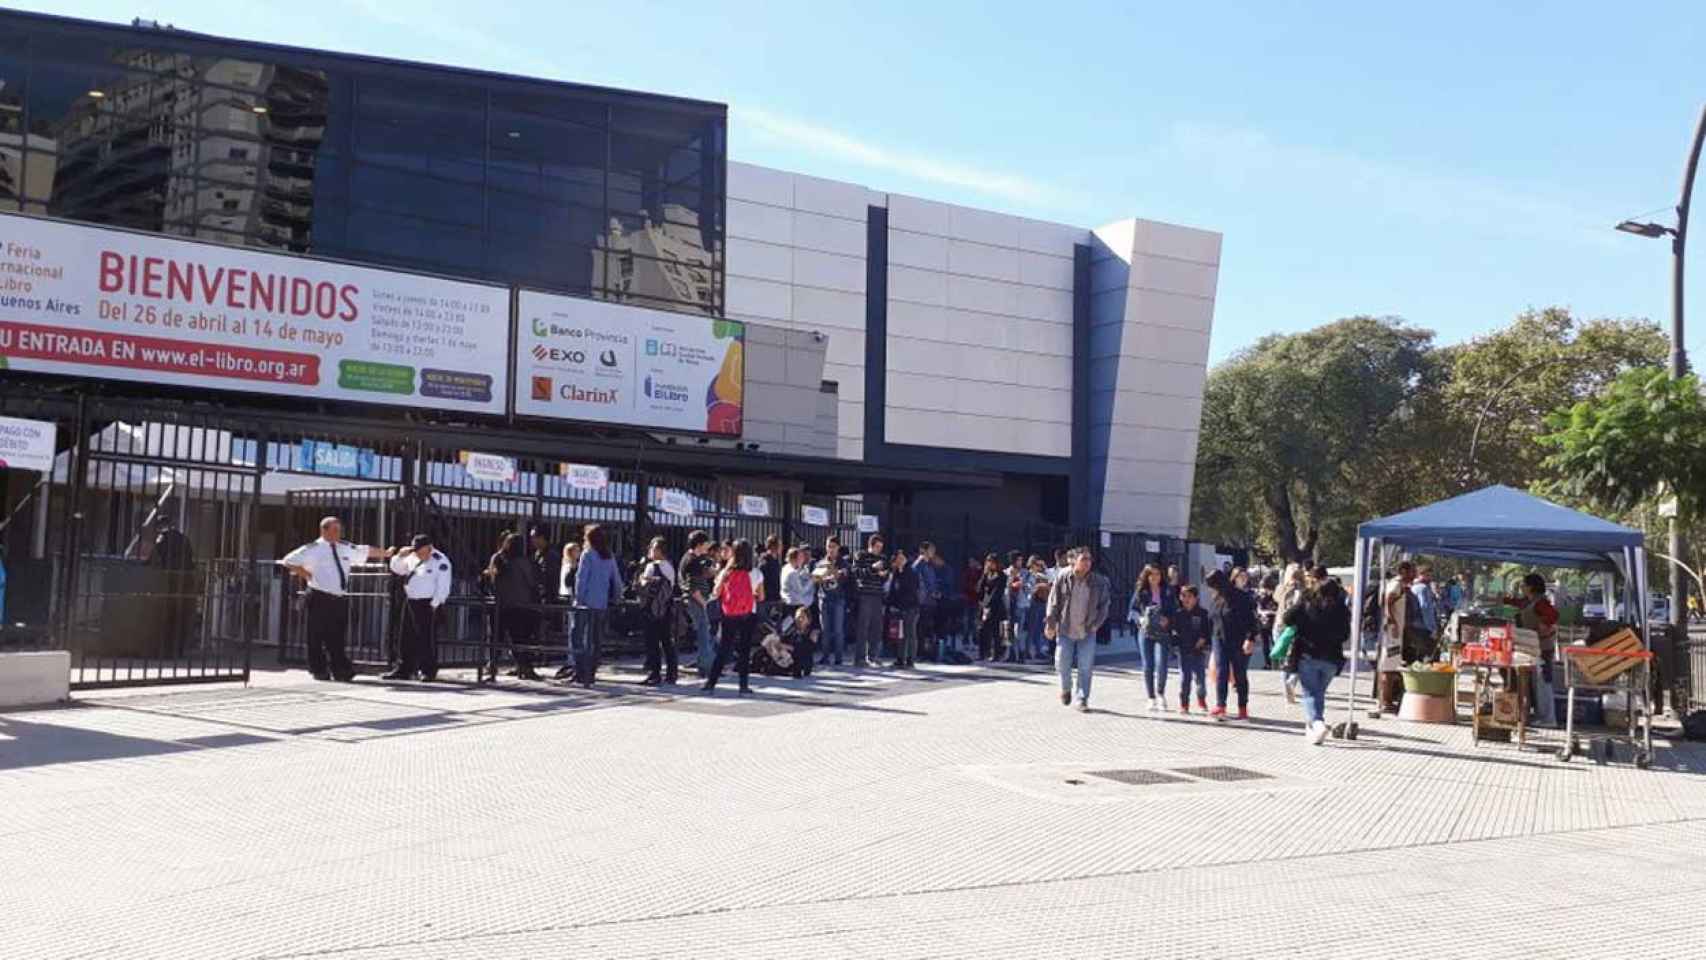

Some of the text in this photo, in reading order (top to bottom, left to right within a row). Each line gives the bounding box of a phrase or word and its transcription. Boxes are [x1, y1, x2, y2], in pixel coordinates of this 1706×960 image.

[7, 242, 41, 260] Feria
[98, 250, 360, 322] BIENVENIDOS
[46, 297, 81, 315] Aires
[98, 300, 343, 350] Del 26 de abril al 14 de mayo
[550, 323, 628, 345] Banco Provincia
[18, 332, 105, 357] ENTRADA
[112, 343, 136, 361] EN
[142, 349, 308, 380] www.el-libro.org.ar
[550, 349, 585, 364] EXO
